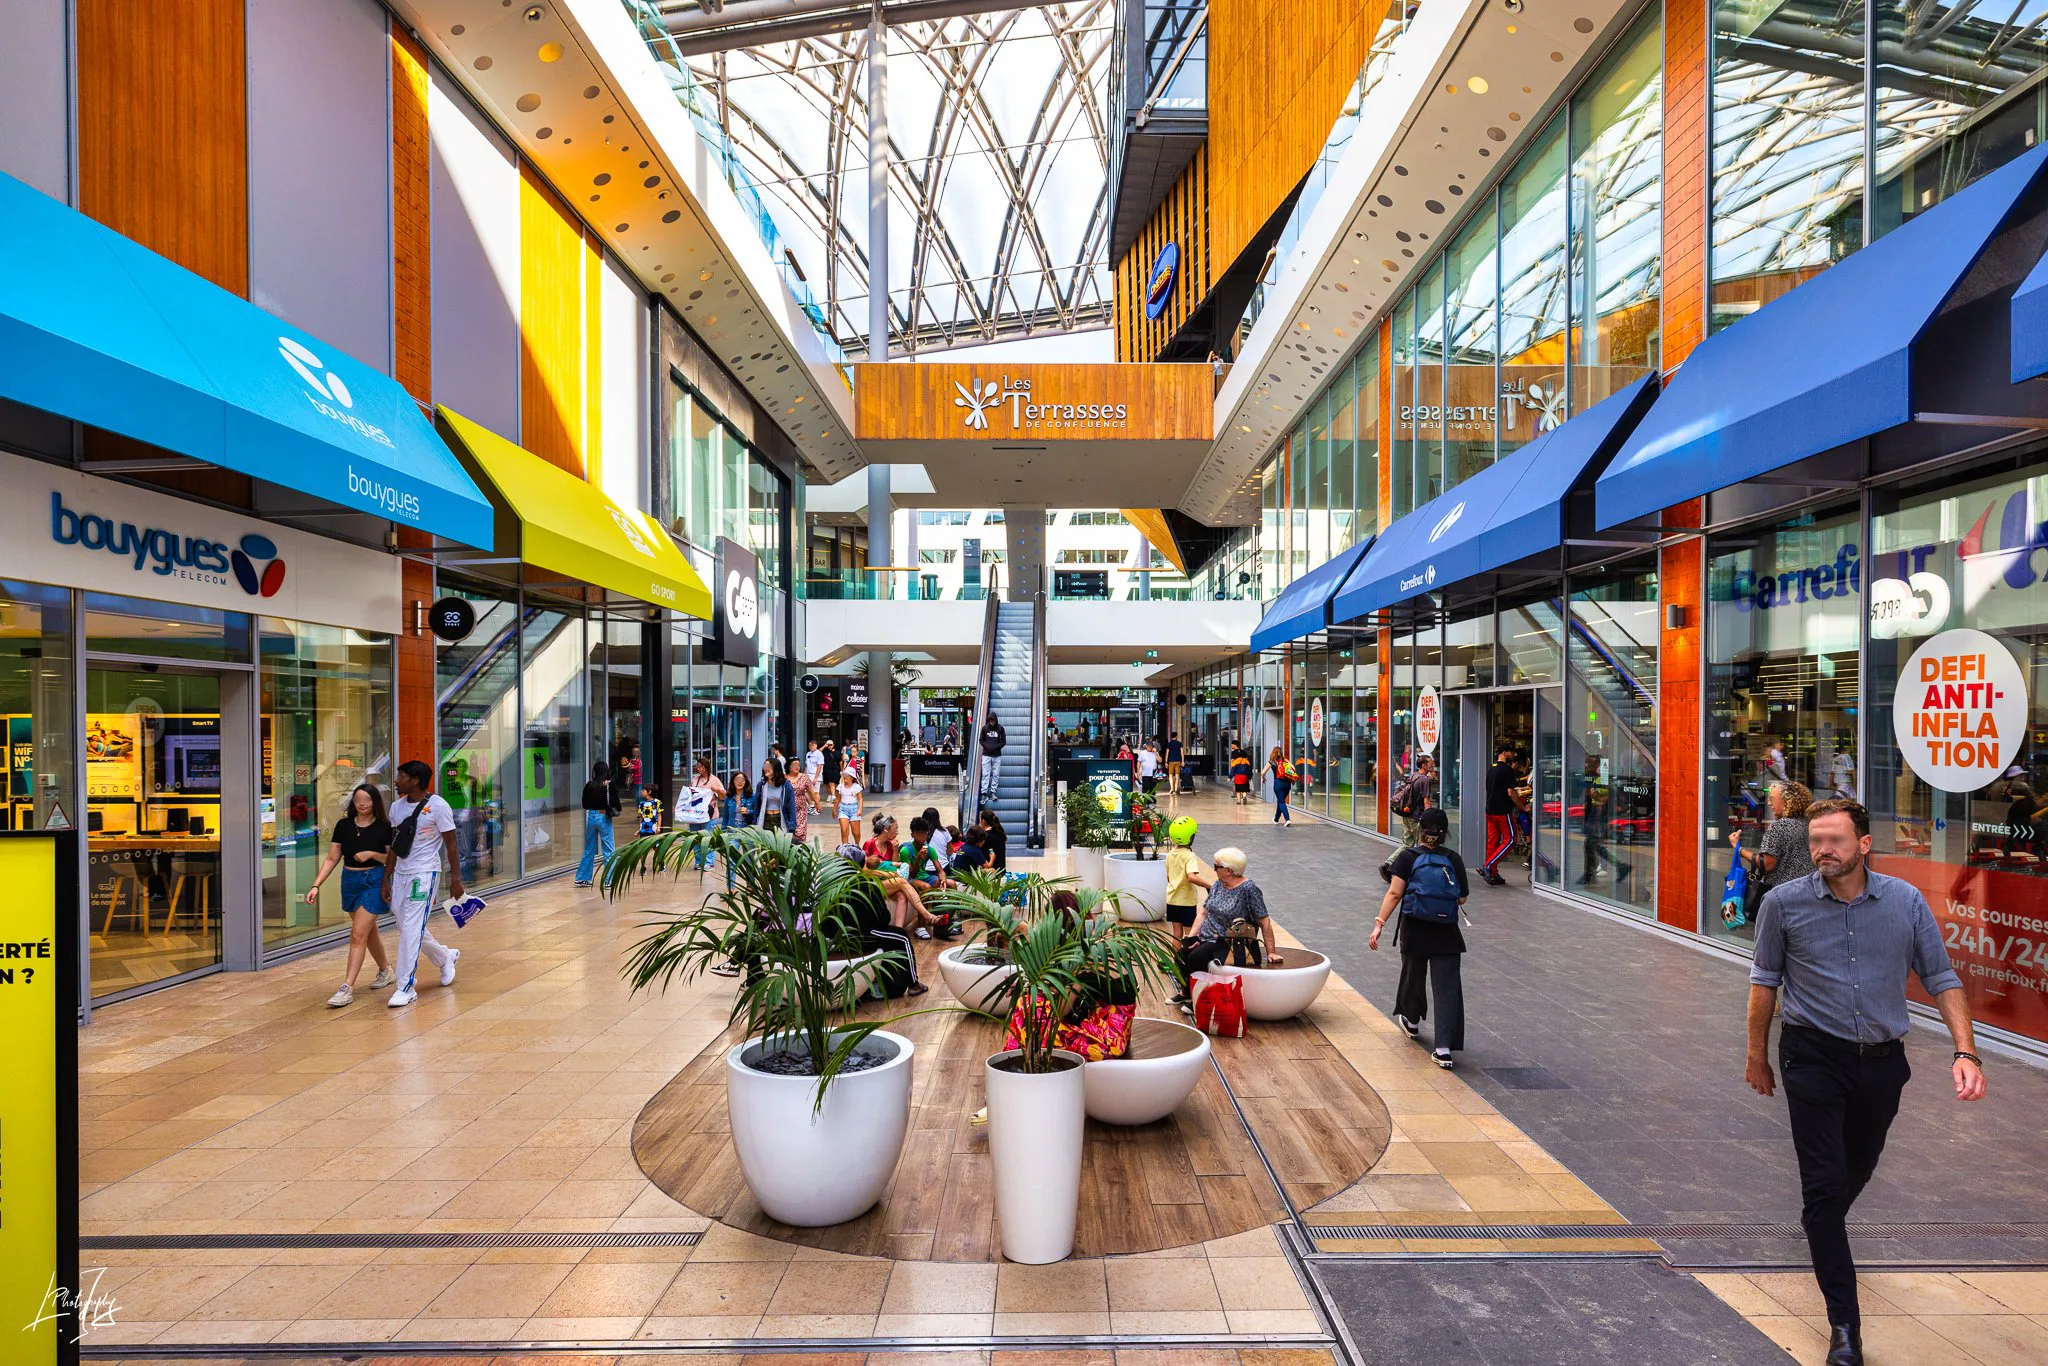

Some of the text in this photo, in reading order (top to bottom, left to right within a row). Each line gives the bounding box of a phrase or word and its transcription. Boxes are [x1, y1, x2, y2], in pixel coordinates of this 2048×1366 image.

[1003, 374, 1031, 391] Les
[304, 390, 391, 443] bouygues
[1002, 392, 1127, 429] Terrasses
[1026, 420, 1126, 428] DE CONFLUENCE
[348, 464, 420, 513] bouygues
[395, 507, 420, 521] TELECOM
[51, 491, 230, 576] bouygues
[172, 568, 227, 586] TELECOM
[1058, 576, 1064, 590] 1
[1400, 574, 1424, 592] Carrefour
[1732, 543, 1937, 613] Carrefr
[650, 583, 676, 601] GO SPORT
[1920, 653, 1986, 683] DEFI
[1421, 696, 1434, 708] DEFI
[1922, 682, 2004, 710] ANTI-
[1421, 708, 1437, 719] ANTI-
[1420, 719, 1436, 731] INFLA
[1912, 712, 1999, 739] INFLA
[1422, 732, 1436, 744] TION
[924, 759, 950, 767] Confluence
[1926, 741, 1999, 769] TION
[1104, 773, 1129, 781] enfants
[1971, 822, 2011, 836] ENTRÉE
[1945, 898, 2048, 934] Vos courses
[1949, 958, 1966, 970] ur
[21, 967, 35, 985] ?
